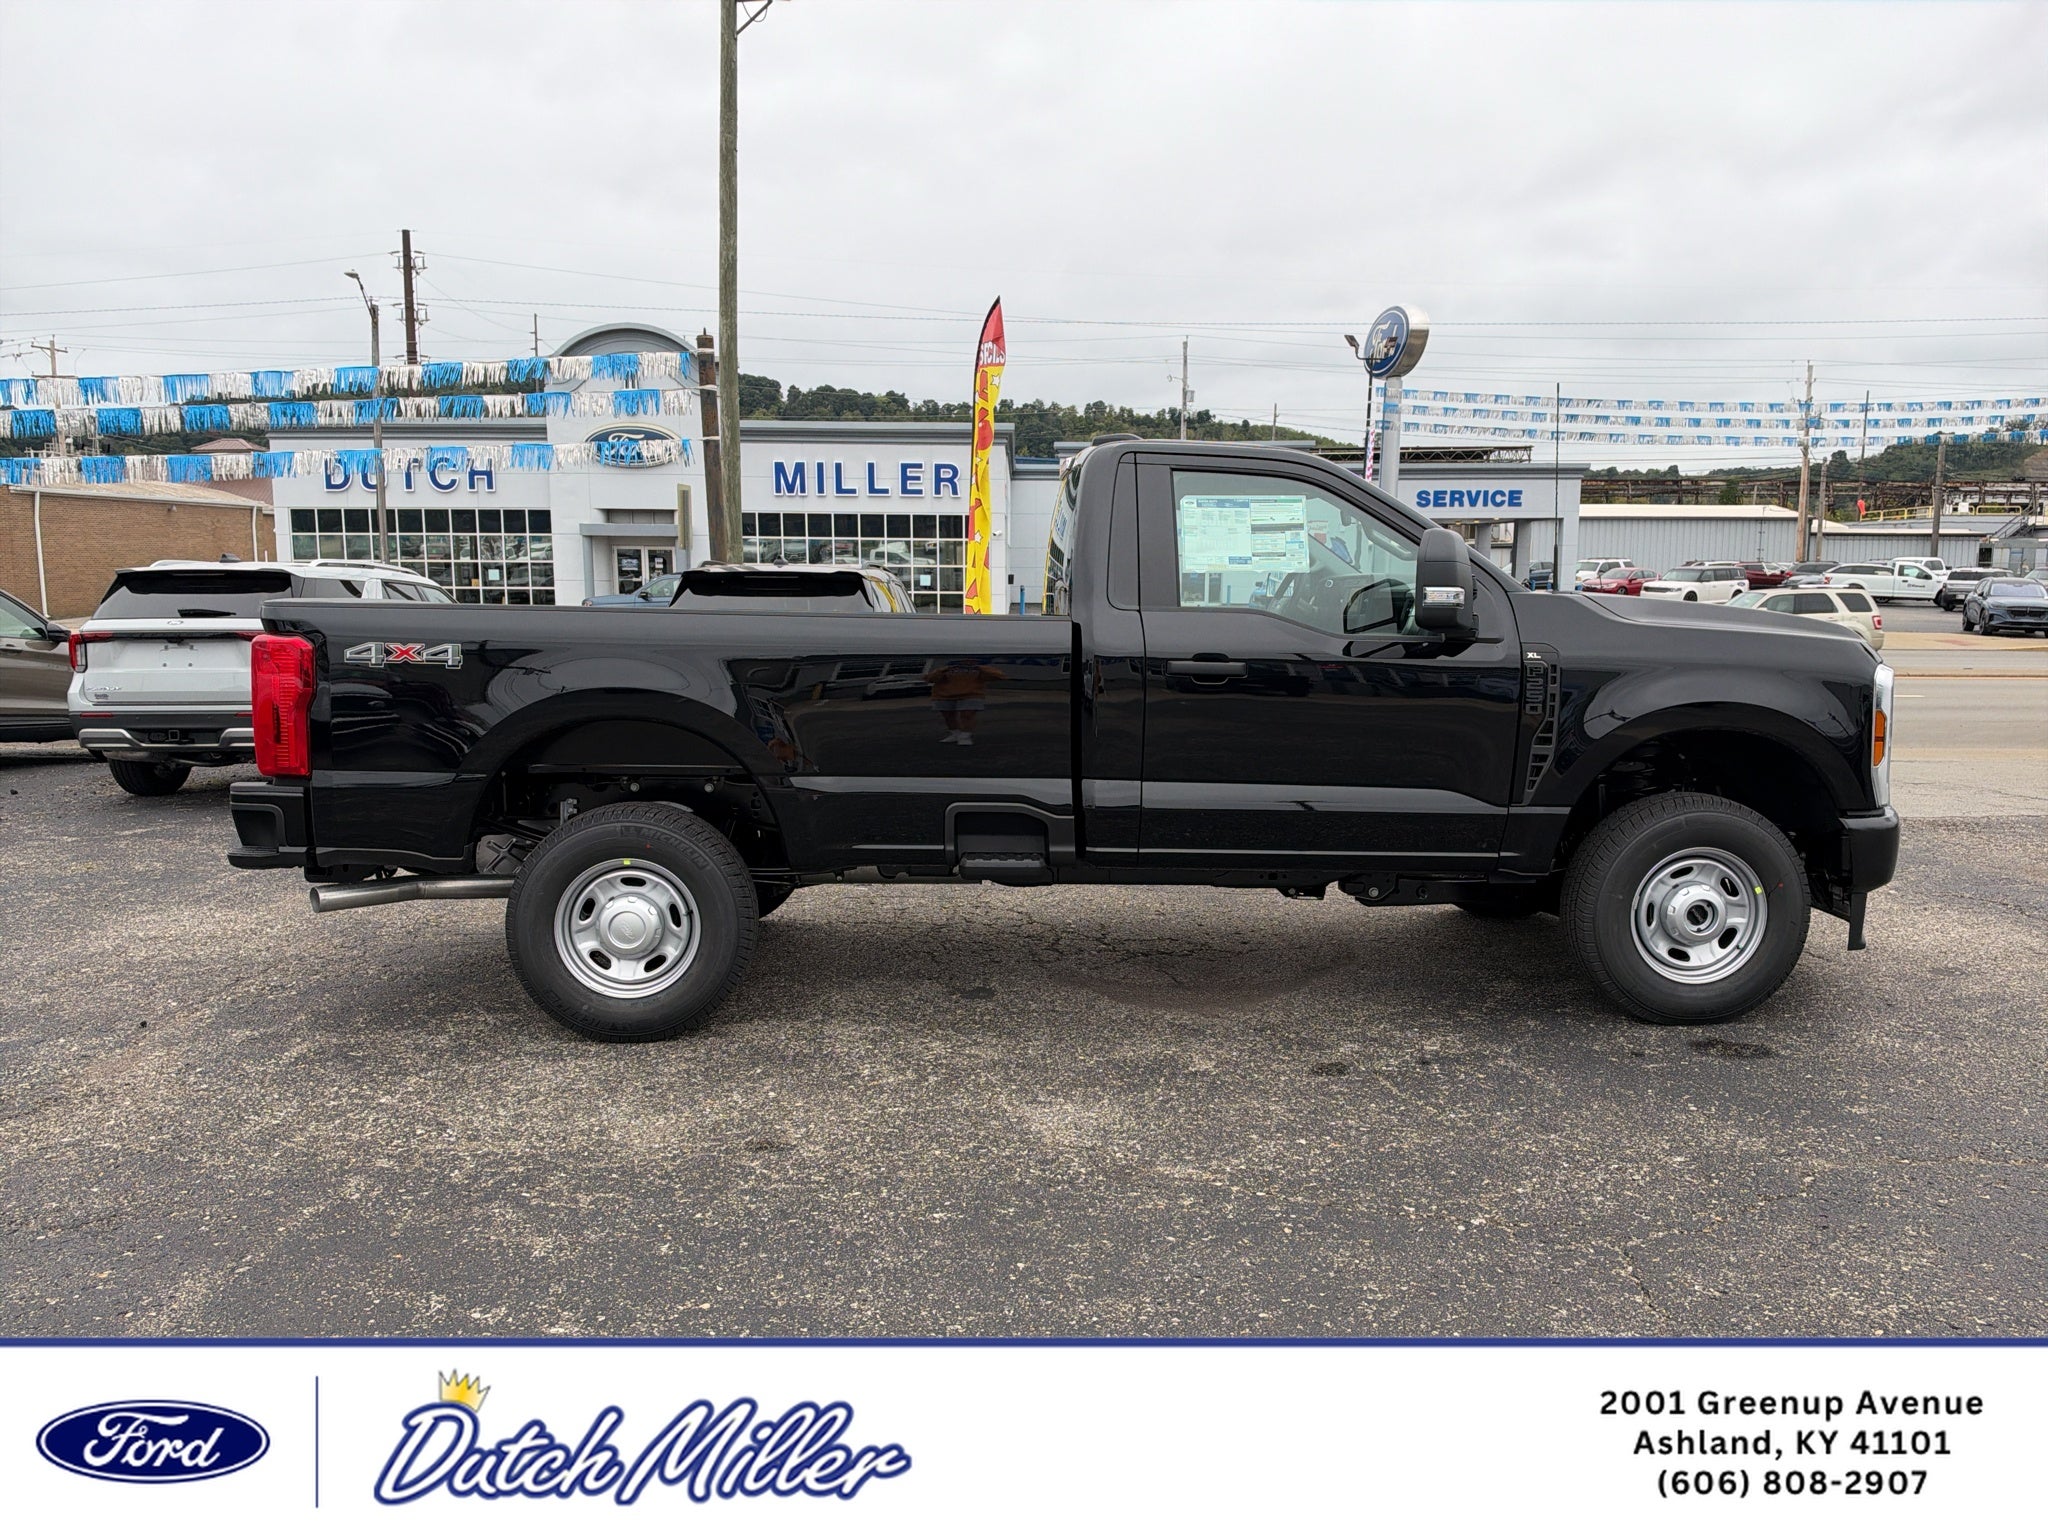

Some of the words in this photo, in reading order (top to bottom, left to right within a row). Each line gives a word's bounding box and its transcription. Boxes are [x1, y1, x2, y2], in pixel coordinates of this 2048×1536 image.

[772, 459, 961, 498] MILLER
[1416, 489, 1523, 508] SERVICE
[1526, 651, 1542, 659] XL
